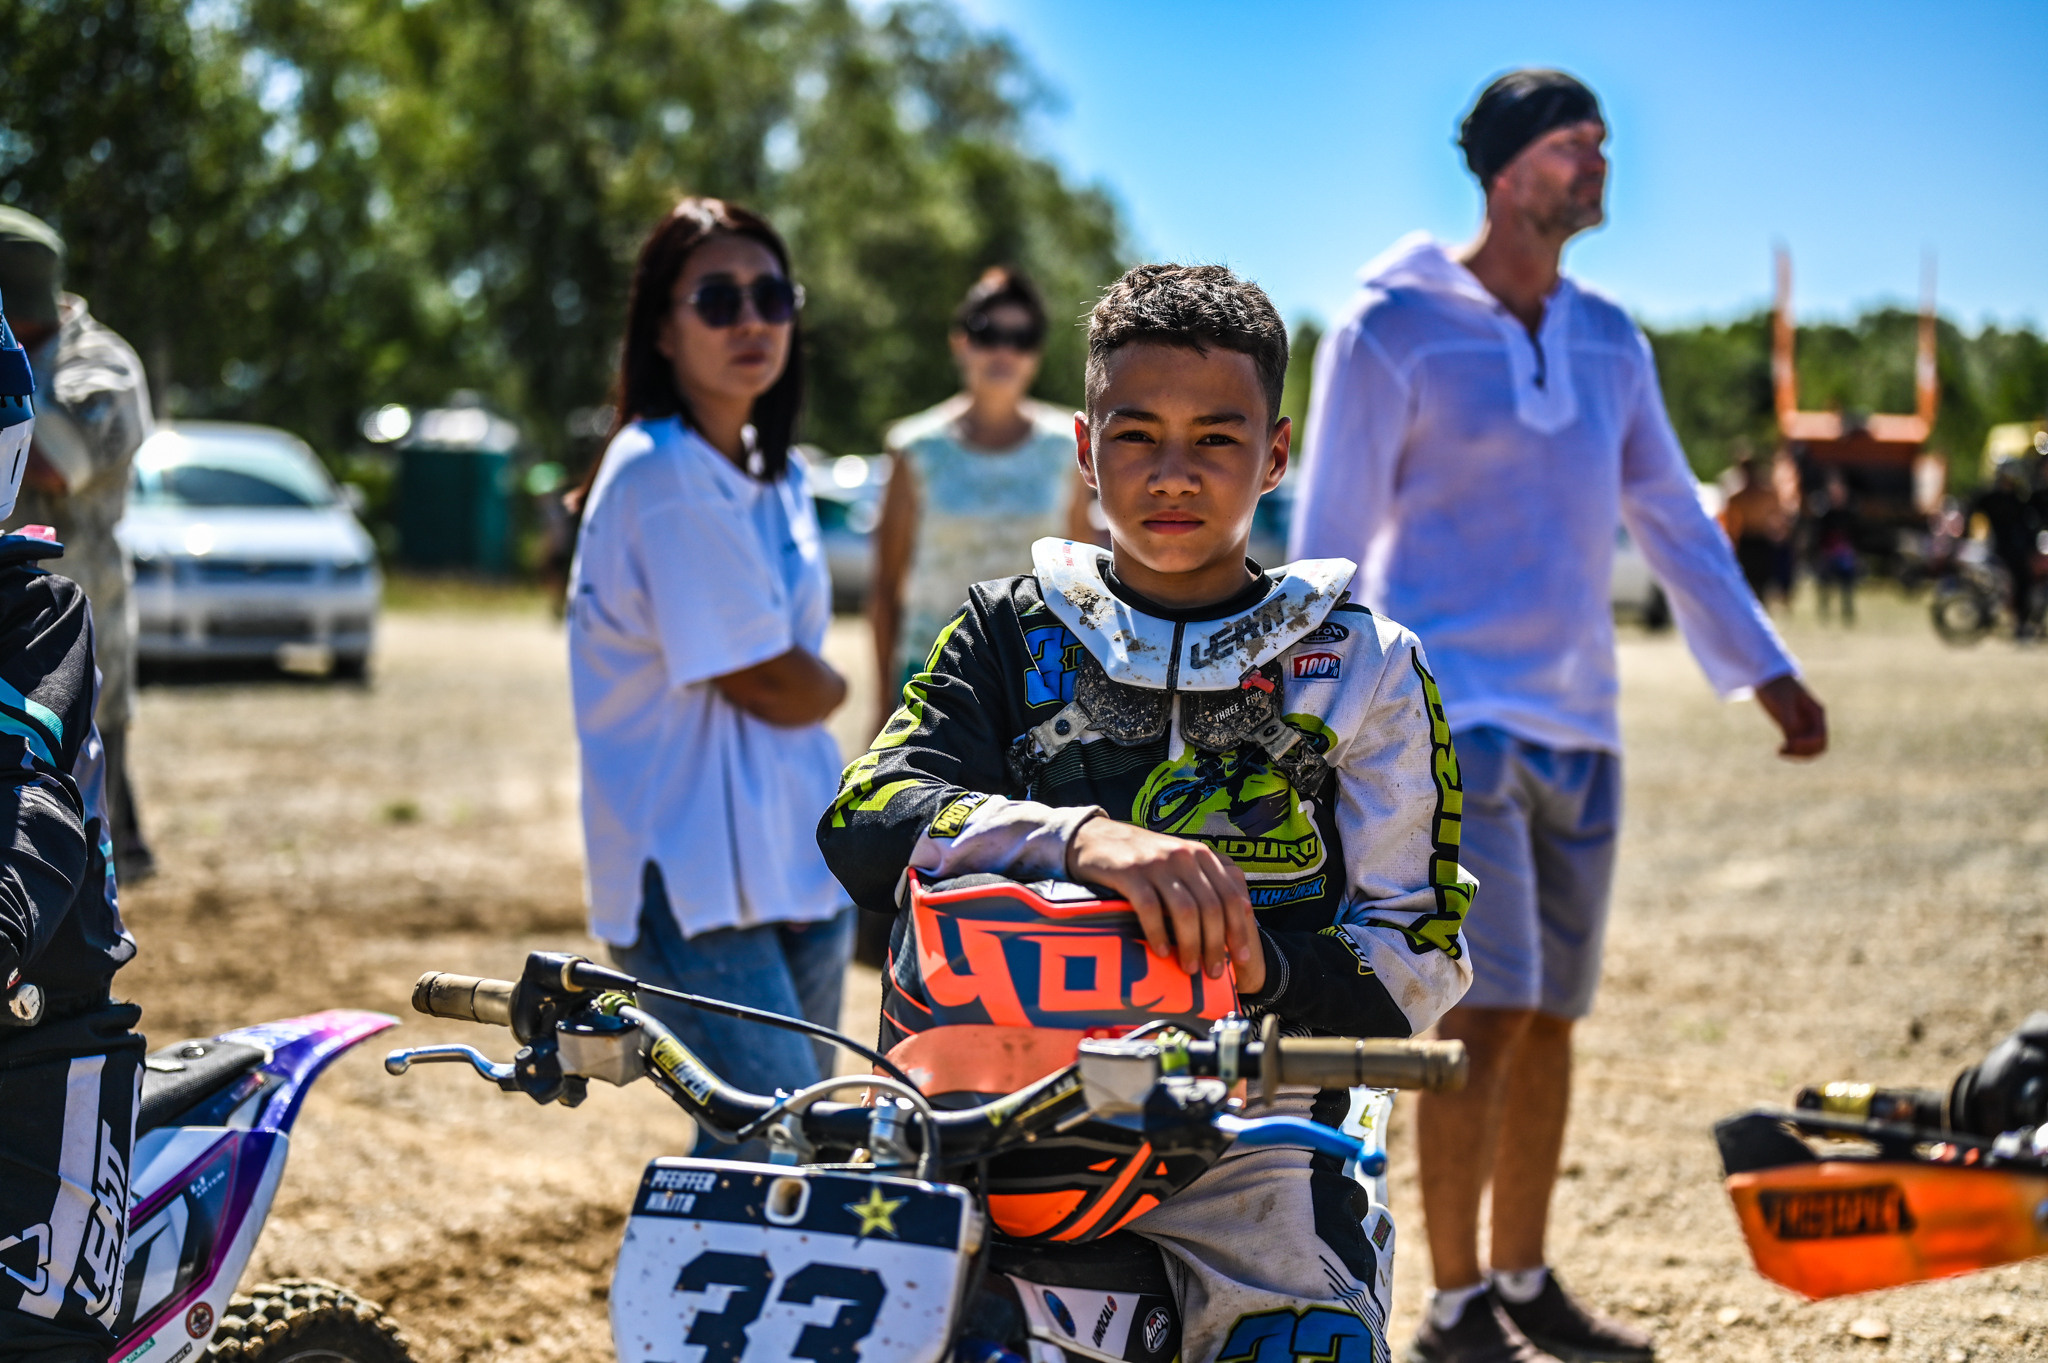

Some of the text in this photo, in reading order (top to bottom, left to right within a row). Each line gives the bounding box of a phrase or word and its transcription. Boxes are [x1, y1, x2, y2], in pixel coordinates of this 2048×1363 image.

[1299, 656, 1339, 677] 100%
[1215, 690, 1263, 723] THREE FIVE
[1092, 1304, 1114, 1348] UNOCAL
[1146, 1312, 1169, 1349] Airoh
